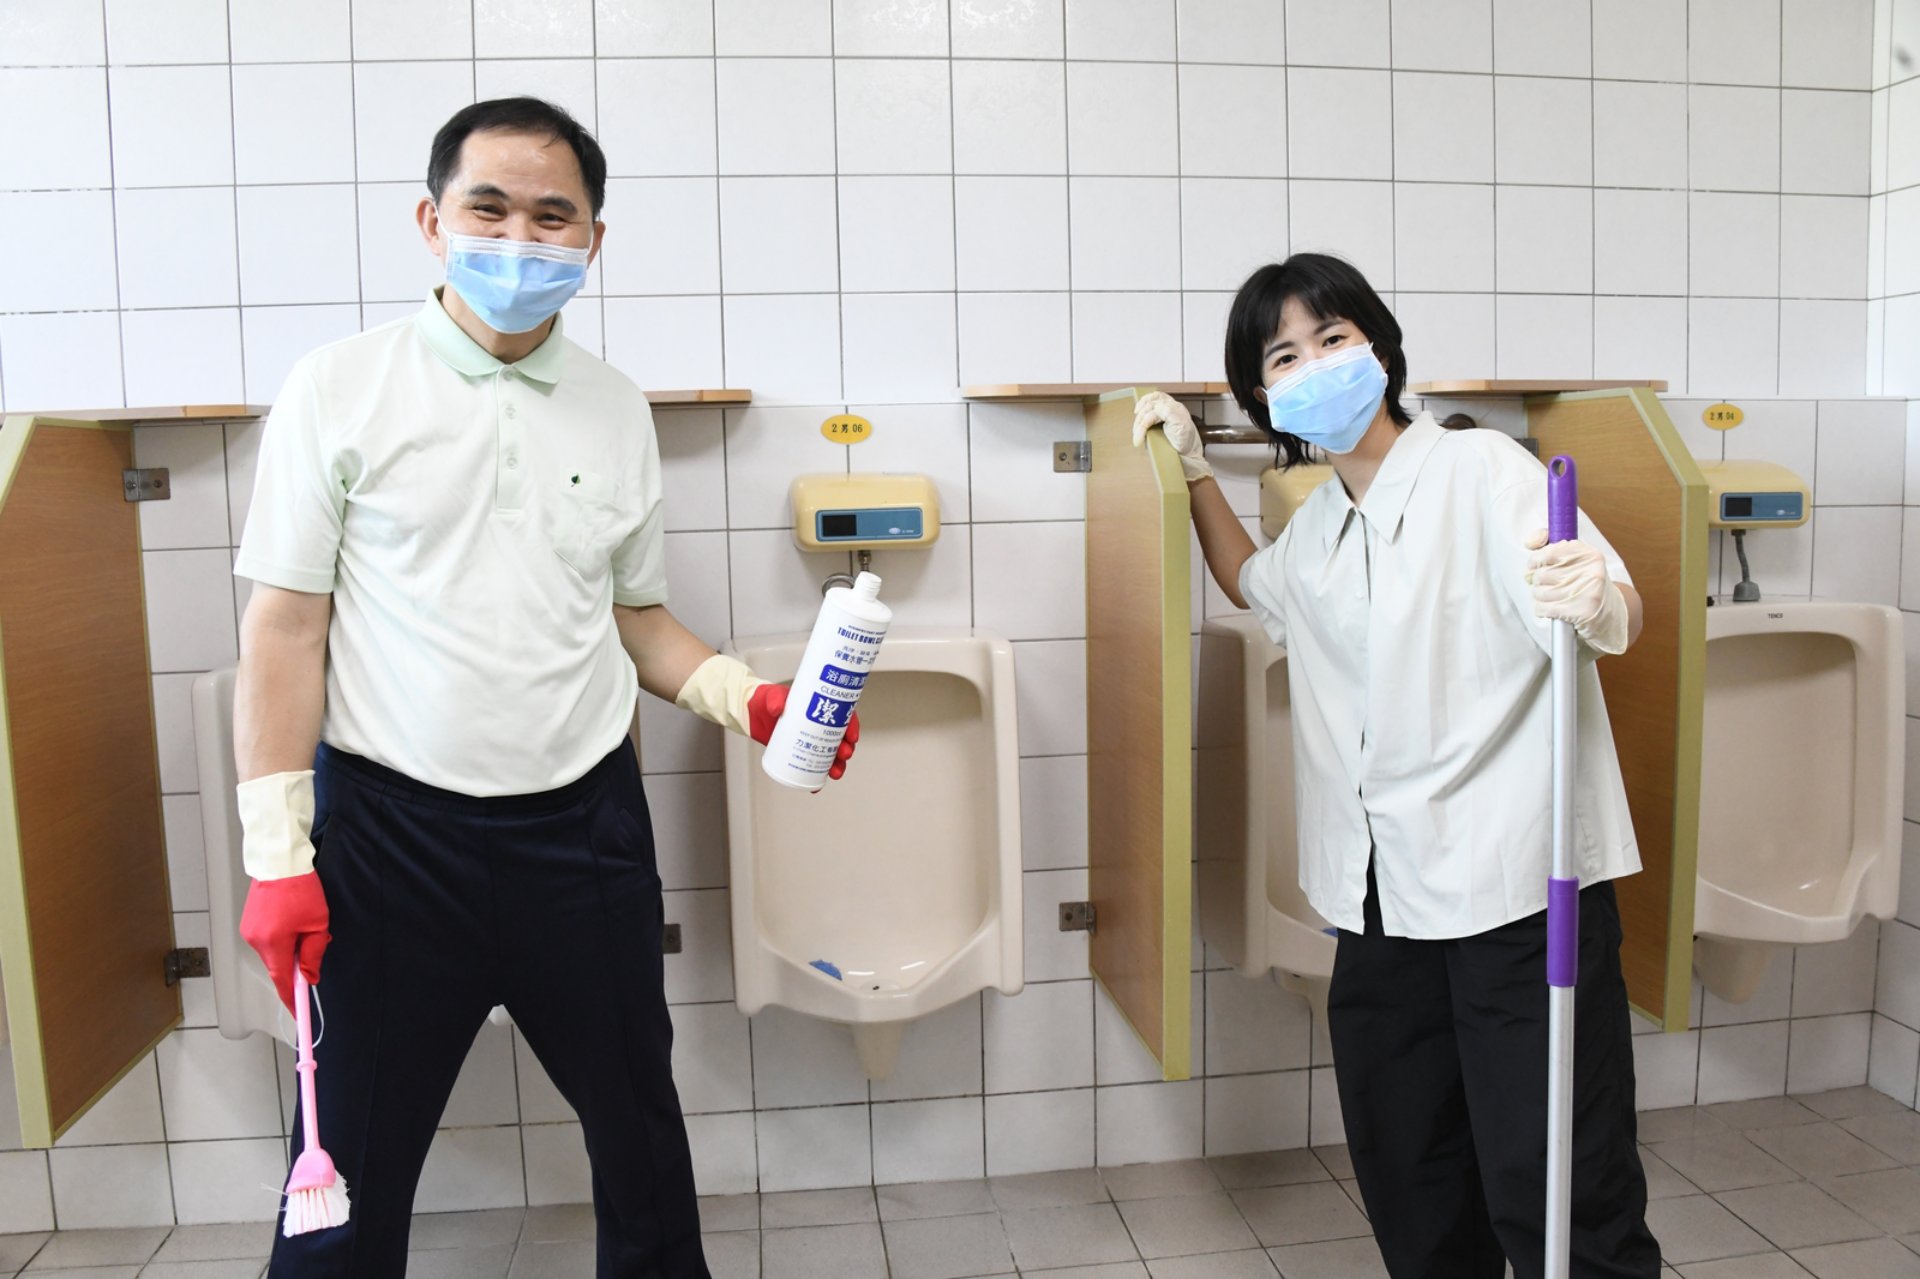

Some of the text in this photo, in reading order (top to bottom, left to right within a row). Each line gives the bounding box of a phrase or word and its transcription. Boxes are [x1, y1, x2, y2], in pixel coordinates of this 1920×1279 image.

[852, 423, 863, 433] 06
[838, 627, 859, 641] TOILET
[858, 635, 876, 644] BOWL
[820, 685, 855, 699] CLEANER
